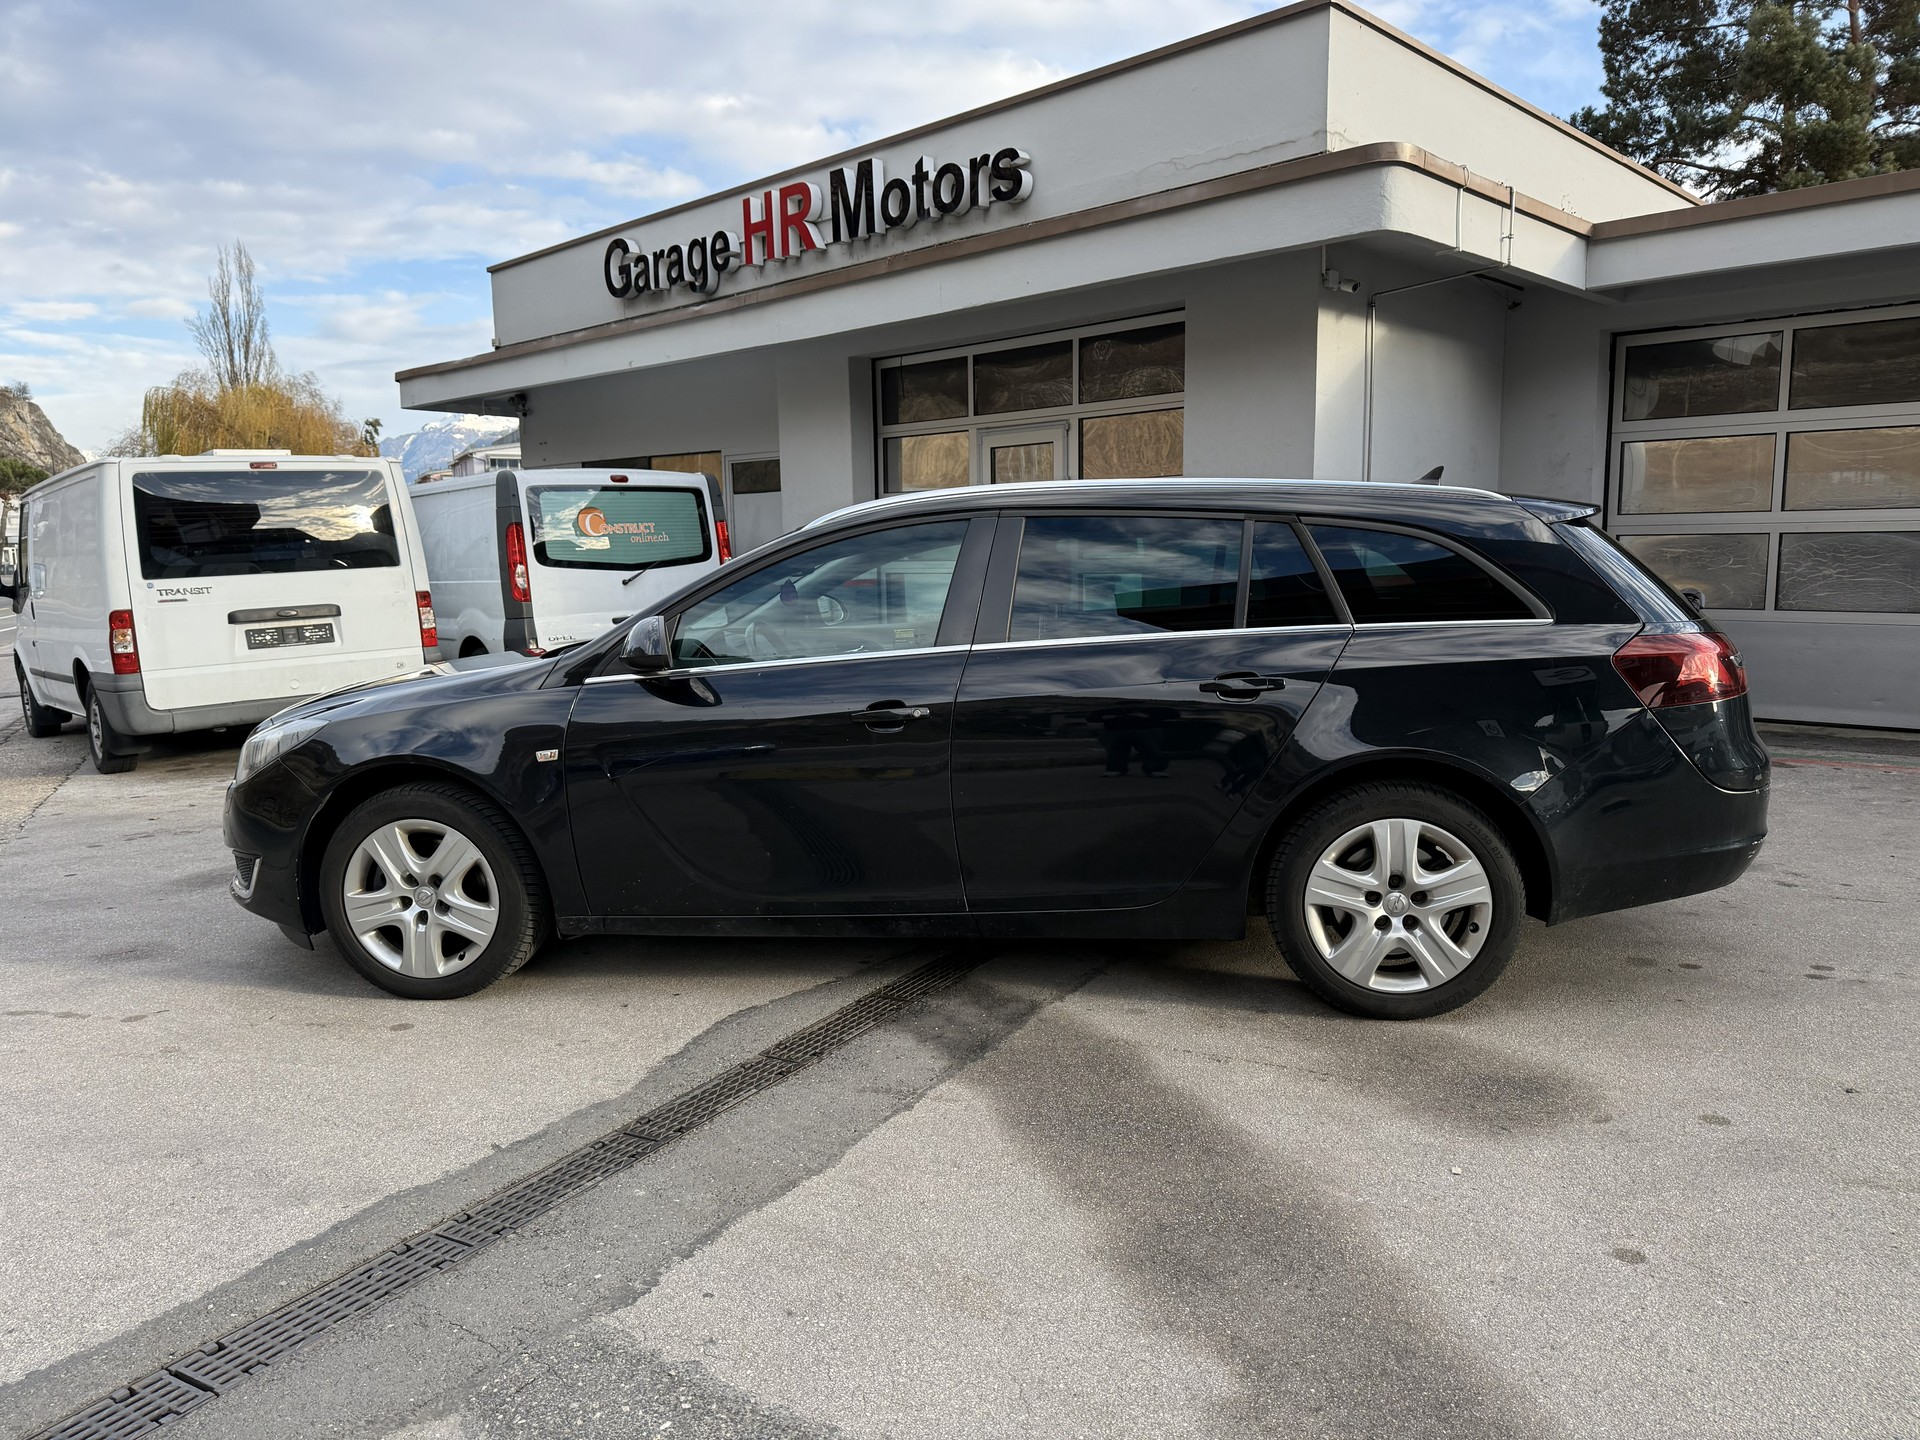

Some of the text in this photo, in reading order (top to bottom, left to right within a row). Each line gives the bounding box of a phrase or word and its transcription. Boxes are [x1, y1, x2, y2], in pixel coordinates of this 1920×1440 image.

[604, 147, 1034, 300] Garage HR Motors
[156, 586, 213, 597] TRANSIT
